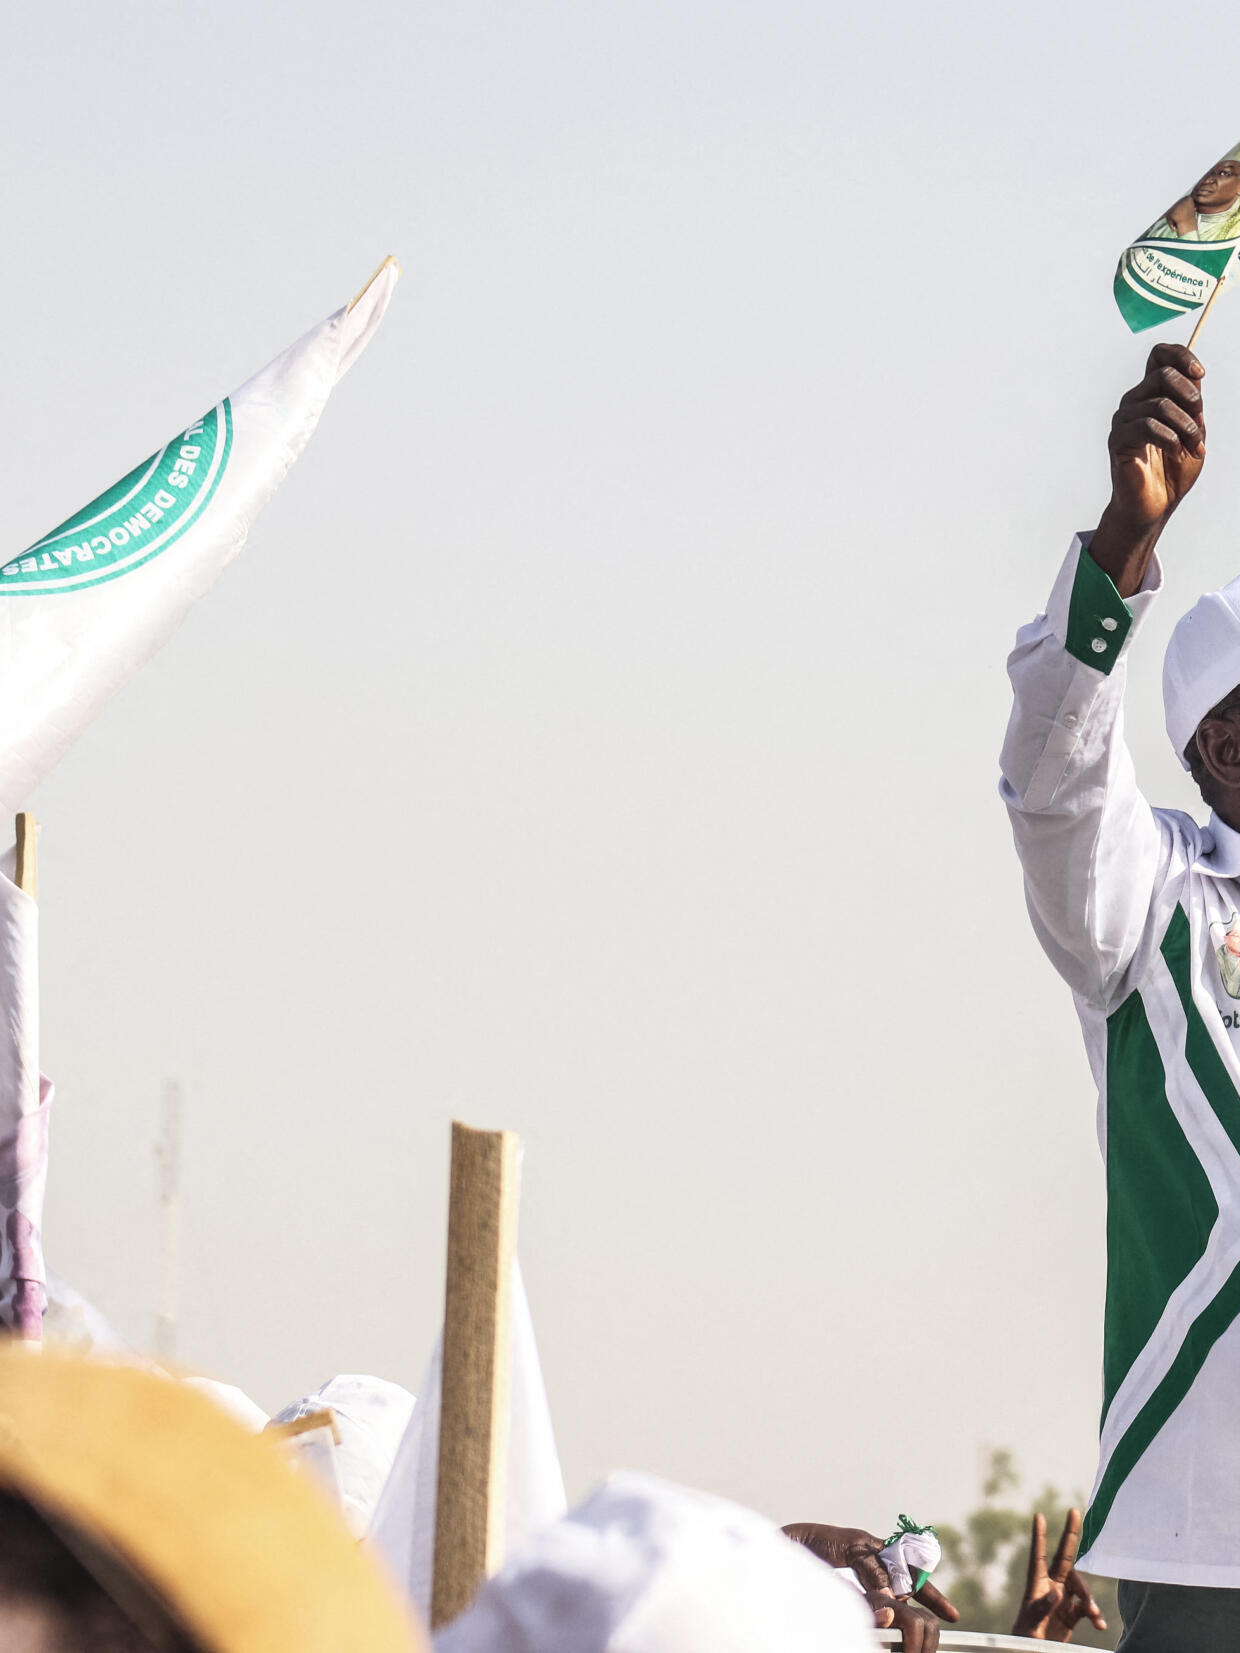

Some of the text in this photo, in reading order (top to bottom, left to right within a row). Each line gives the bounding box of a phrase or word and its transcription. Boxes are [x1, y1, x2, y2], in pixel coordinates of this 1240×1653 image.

[1146, 254, 1155, 263] de
[1153, 258, 1204, 288] l'expérience
[167, 445, 202, 490] DES
[1, 489, 177, 577] DEMOCRATES
